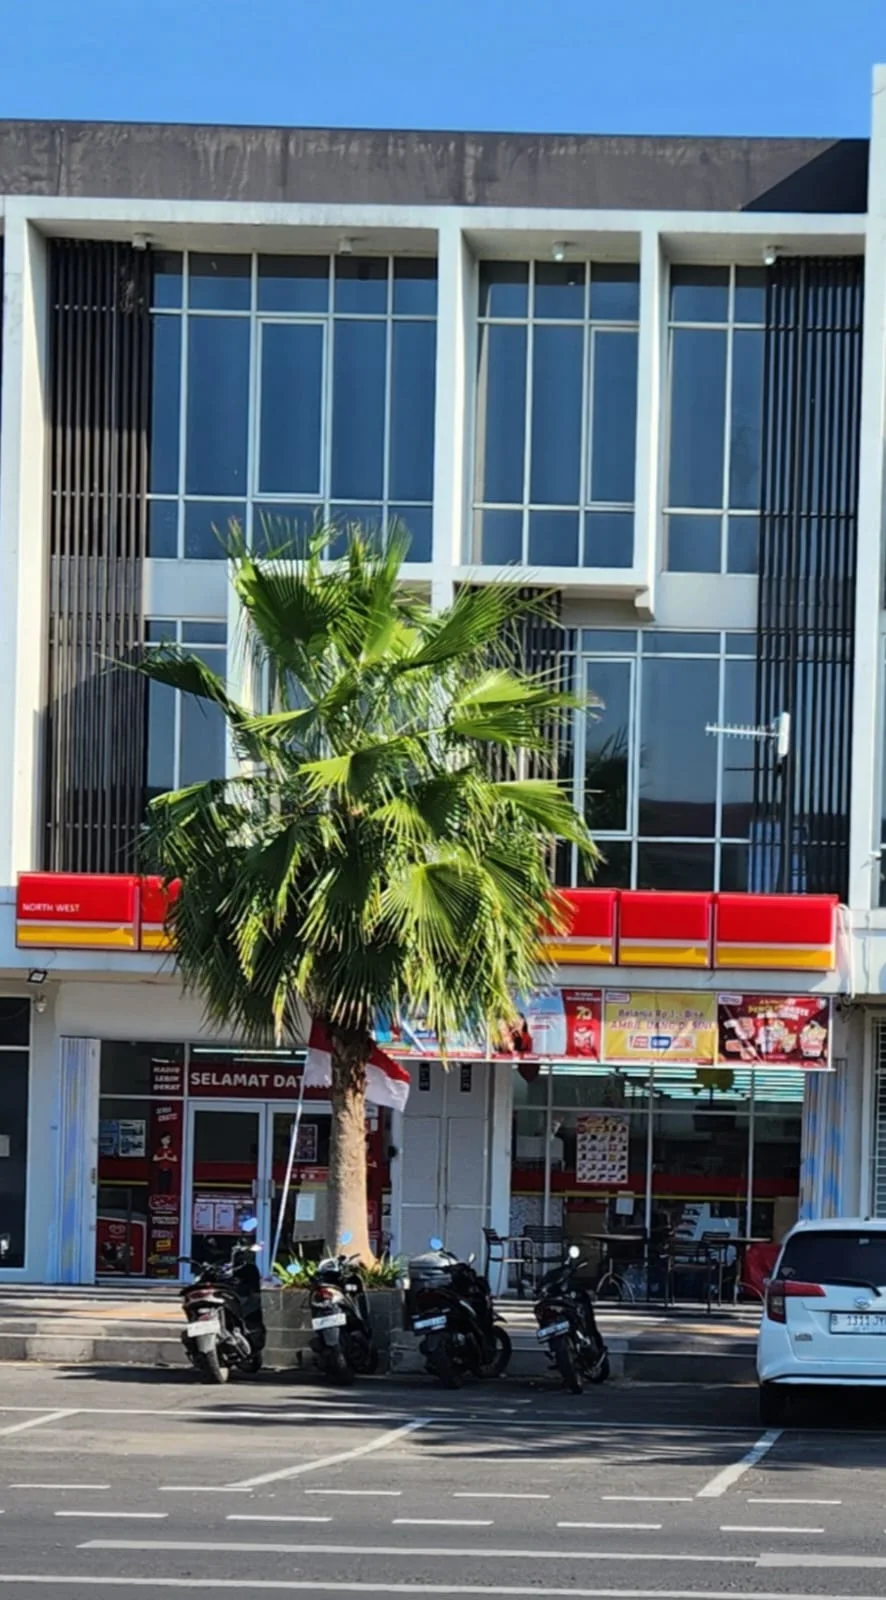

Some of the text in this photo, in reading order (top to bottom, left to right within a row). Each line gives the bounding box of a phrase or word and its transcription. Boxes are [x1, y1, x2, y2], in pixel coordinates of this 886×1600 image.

[22, 903, 80, 913] NORTH WEST
[190, 1072, 270, 1088] SELAMAT
